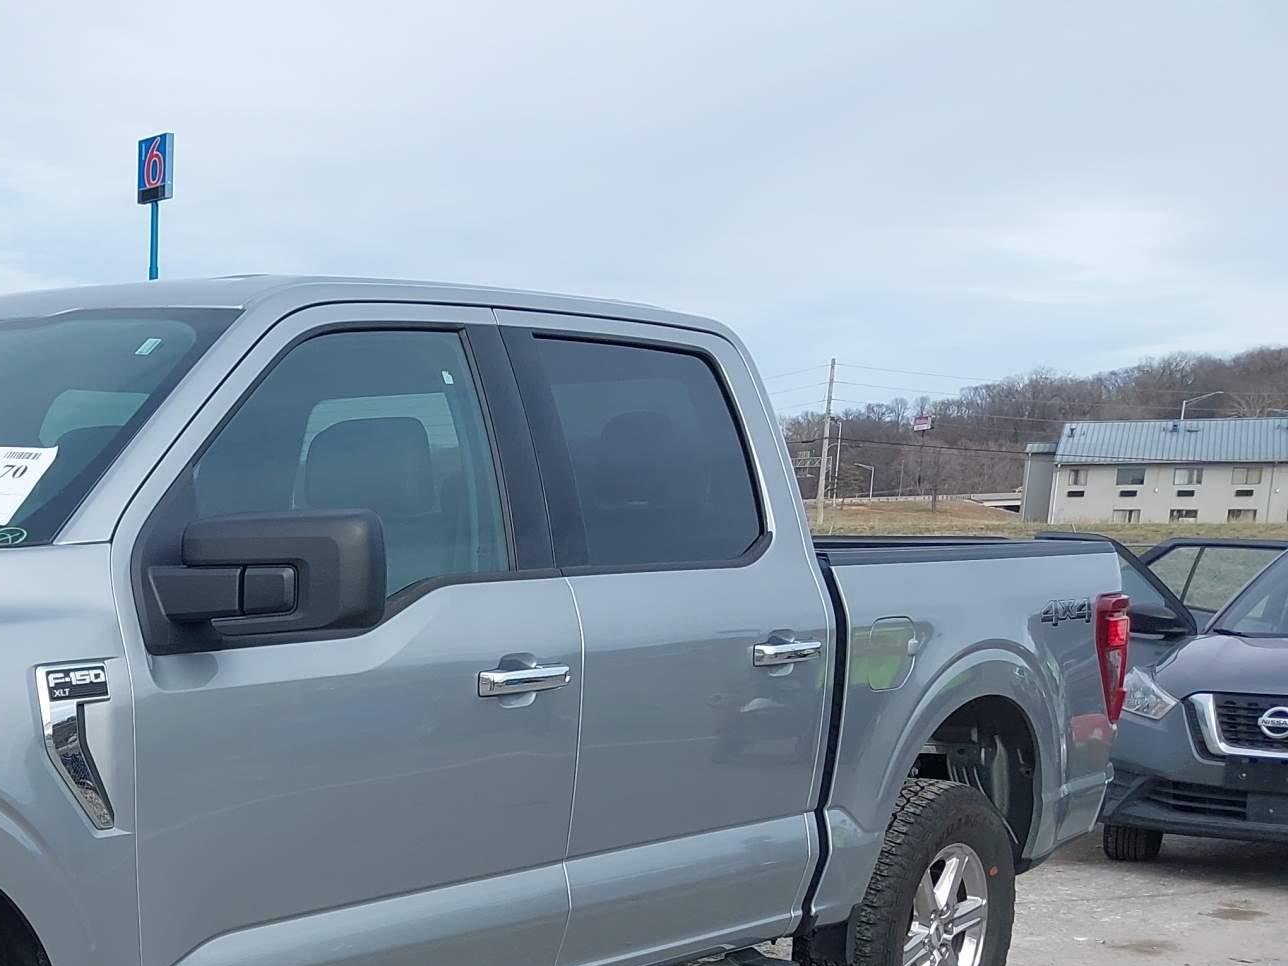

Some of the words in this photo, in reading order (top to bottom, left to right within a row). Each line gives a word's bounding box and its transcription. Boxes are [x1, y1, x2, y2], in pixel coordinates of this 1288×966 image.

[144, 137, 164, 188] 6
[48, 669, 106, 688] F-150
[53, 688, 71, 698] XLT
[1261, 719, 1288, 727] NISSA
